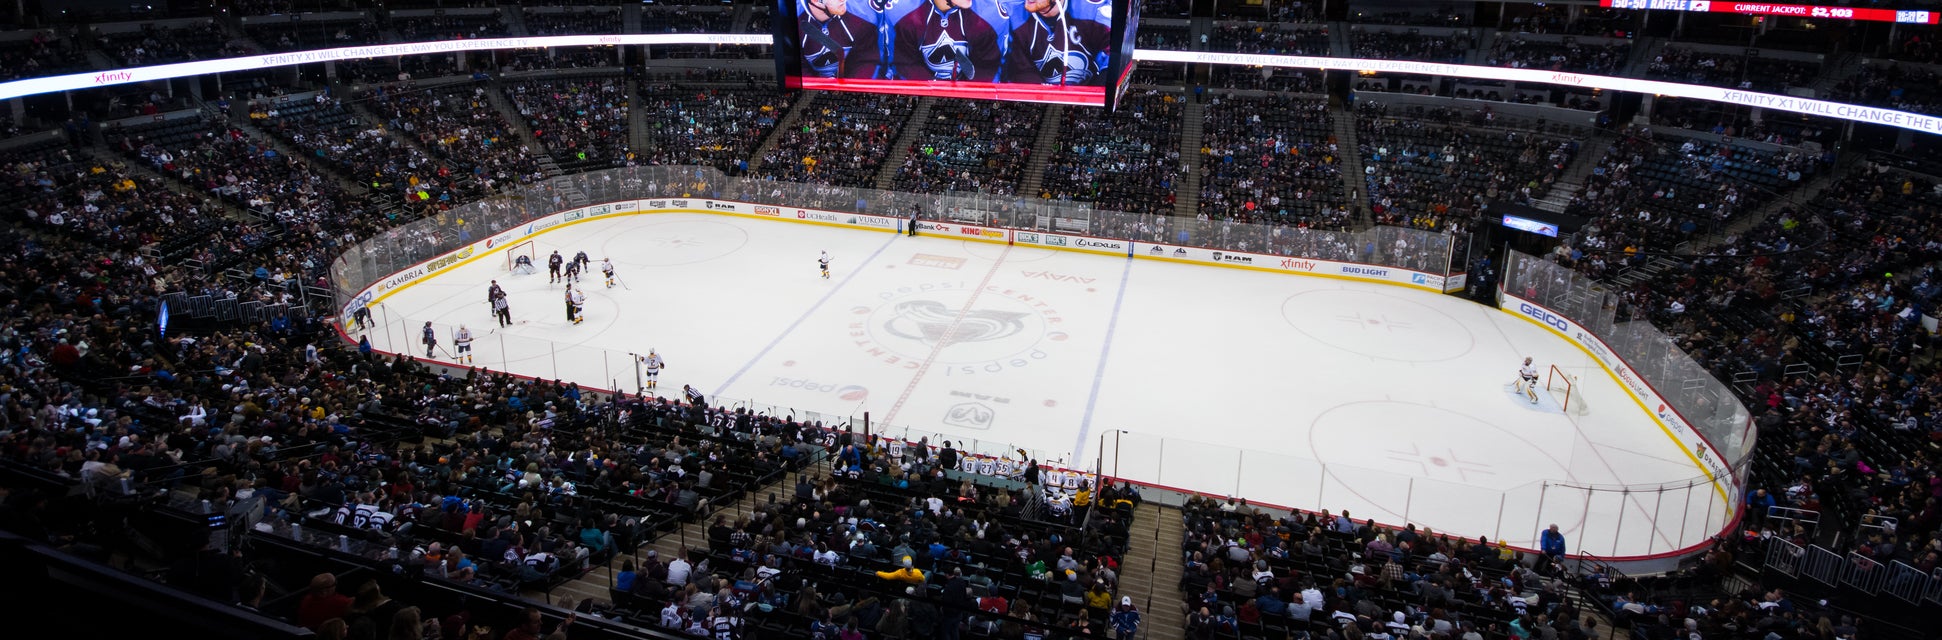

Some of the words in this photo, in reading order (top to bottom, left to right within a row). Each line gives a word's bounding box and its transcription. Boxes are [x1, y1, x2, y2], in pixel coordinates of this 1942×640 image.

[1651, 0, 1687, 11] RAFFLE
[1734, 4, 1771, 12] CURRENT
[1772, 5, 1806, 14] JACKPOT:
[1811, 6, 1853, 18] $2,103
[262, 53, 302, 65] XFINITY
[305, 52, 316, 62] X1
[317, 50, 340, 60] WILL
[343, 47, 386, 57] CHANGE
[390, 46, 408, 54] THE
[412, 44, 432, 53] WAY
[434, 42, 454, 51] YOU
[456, 39, 514, 49] EXPERIENCE
[1270, 58, 1307, 66] CHANGE
[1356, 61, 1376, 69] YOU
[1380, 62, 1444, 72] EXPERIENCE
[1446, 66, 1459, 74] TV
[95, 72, 132, 84] xfinity
[1552, 73, 1583, 84] xfinity
[1722, 90, 1776, 106] XFINITY
[1778, 98, 1794, 109] X1
[1799, 100, 1834, 115] WILL
[1836, 105, 1902, 124] CHANGE
[1905, 115, 1933, 130] THE
[807, 212, 837, 221] UCHealth
[859, 216, 889, 225] VUKOTA
[961, 227, 980, 236] KING
[495, 234, 512, 245] pepsi
[1280, 258, 1316, 271] xfinity
[1342, 266, 1361, 274] BUD
[1362, 268, 1388, 276] LIGHT
[386, 269, 424, 289] CAMBRIA
[1022, 270, 1096, 284] AVAYA
[345, 291, 372, 319] GEICO
[879, 281, 965, 301] pepsi
[986, 285, 1064, 325] CENTER
[1520, 303, 1568, 332] GEICO
[848, 321, 920, 370] CENTER
[946, 347, 1047, 377] pepsi
[768, 376, 838, 393] pepsi
[1666, 414, 1684, 434] pepsi
[824, 436, 835, 447] 29
[967, 462, 973, 472] 9
[982, 464, 992, 474] 27
[1068, 479, 1074, 487] 8
[354, 516, 367, 529] 92
